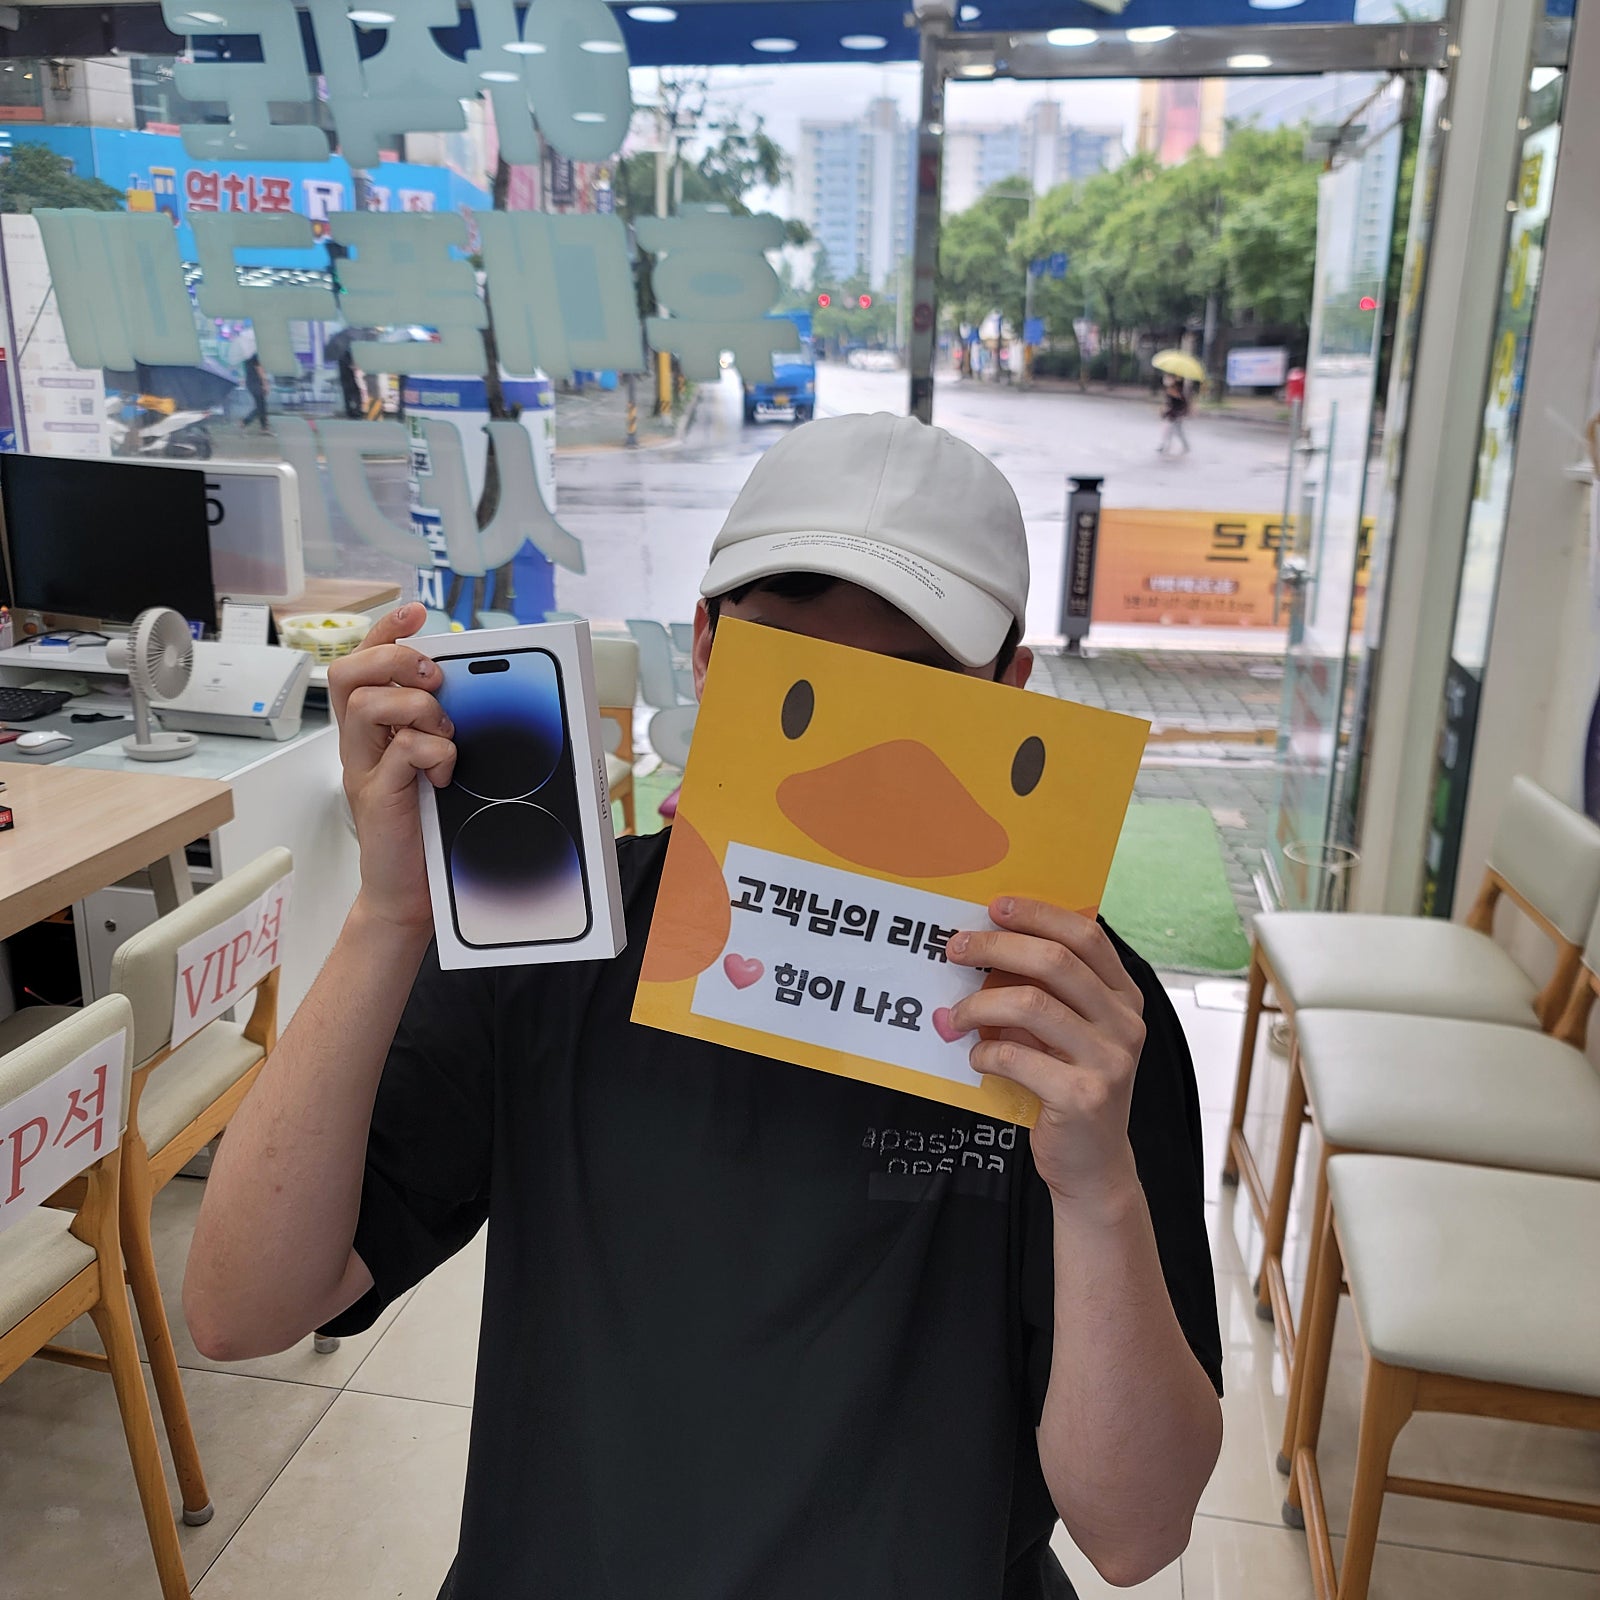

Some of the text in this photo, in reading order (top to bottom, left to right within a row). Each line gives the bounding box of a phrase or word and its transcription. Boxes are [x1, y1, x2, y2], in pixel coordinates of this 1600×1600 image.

[839, 536, 875, 546] GREAT
[876, 544, 910, 562] COMES
[895, 560, 930, 583] products
[886, 558, 934, 592] comfortable
[730, 875, 880, 943] 고객님의
[181, 897, 284, 1020] VIP석
[773, 962, 923, 1032] 힘이 나요
